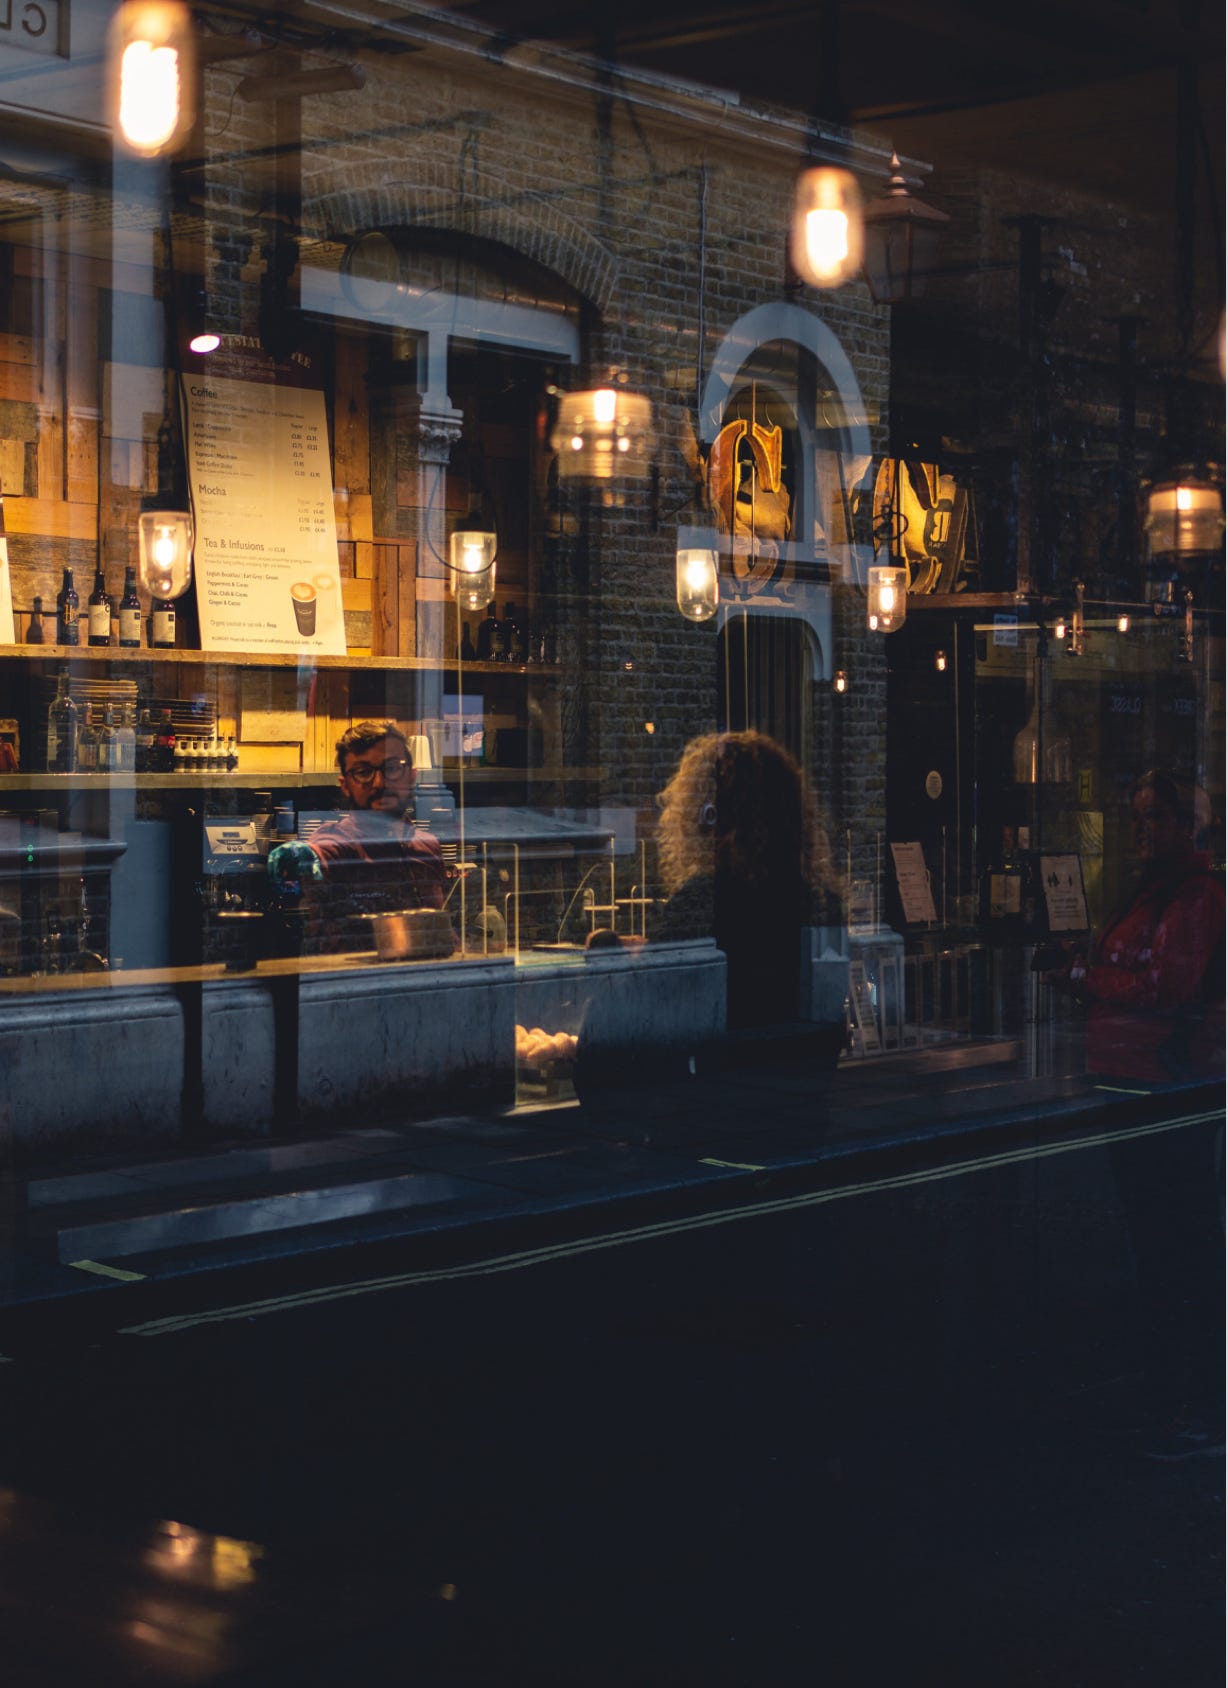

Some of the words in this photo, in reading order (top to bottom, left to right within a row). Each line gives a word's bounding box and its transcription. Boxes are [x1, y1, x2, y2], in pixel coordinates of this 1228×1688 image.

[190, 386, 218, 399] Coffee
[198, 484, 227, 497] Mocha
[204, 537, 218, 549] Tea
[220, 539, 227, 549] &
[229, 539, 265, 552] Infusions
